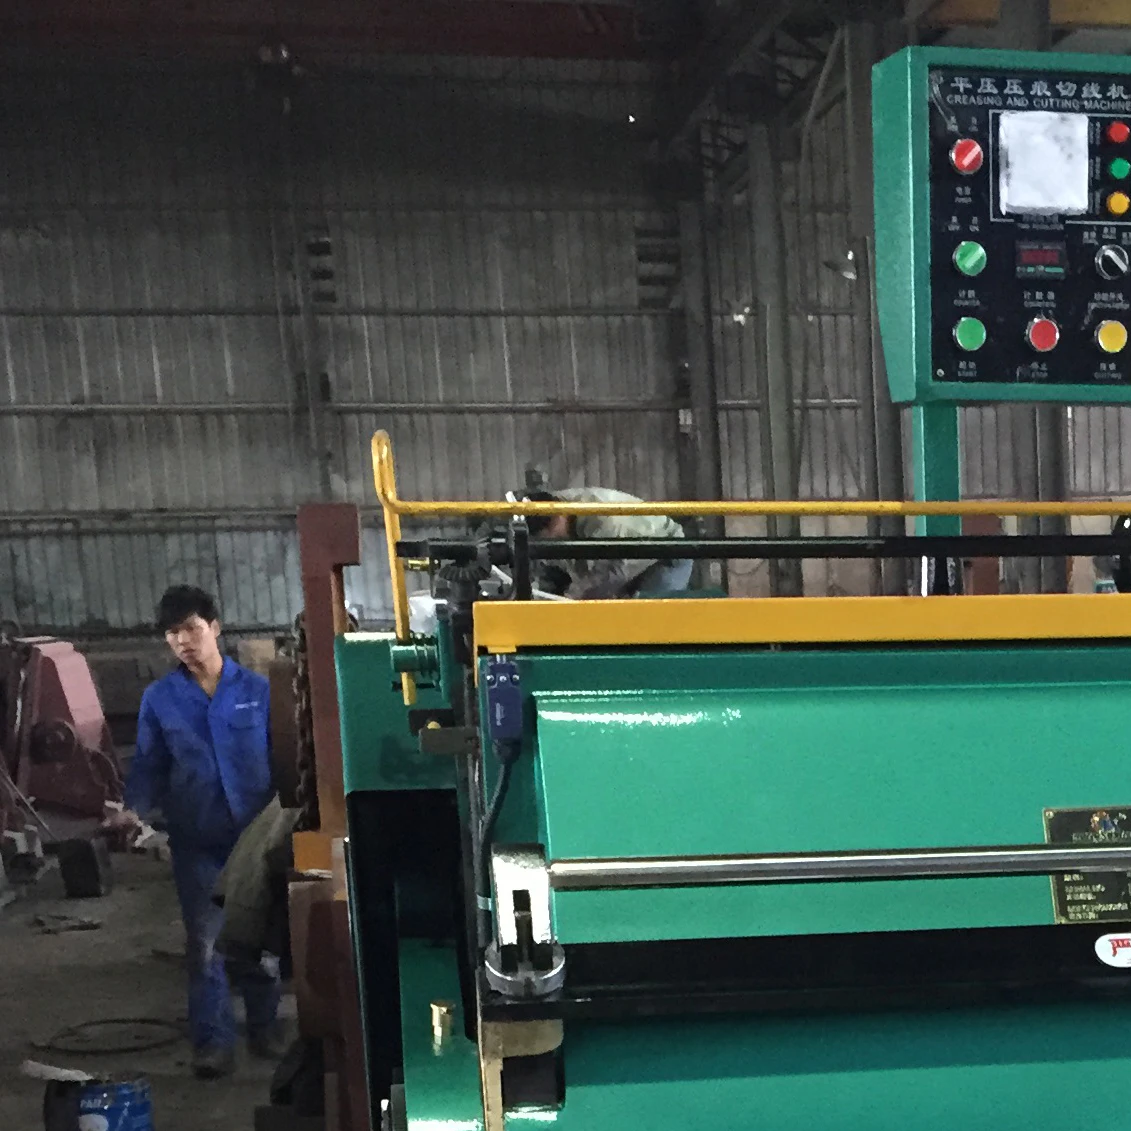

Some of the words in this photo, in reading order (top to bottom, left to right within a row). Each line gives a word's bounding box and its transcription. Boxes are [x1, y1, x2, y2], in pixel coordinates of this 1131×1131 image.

[946, 94, 1002, 106] CREASING
[1006, 97, 1029, 107] AND
[1033, 98, 1080, 109] CUTTING
[1083, 100, 1131, 112] MACHINE
